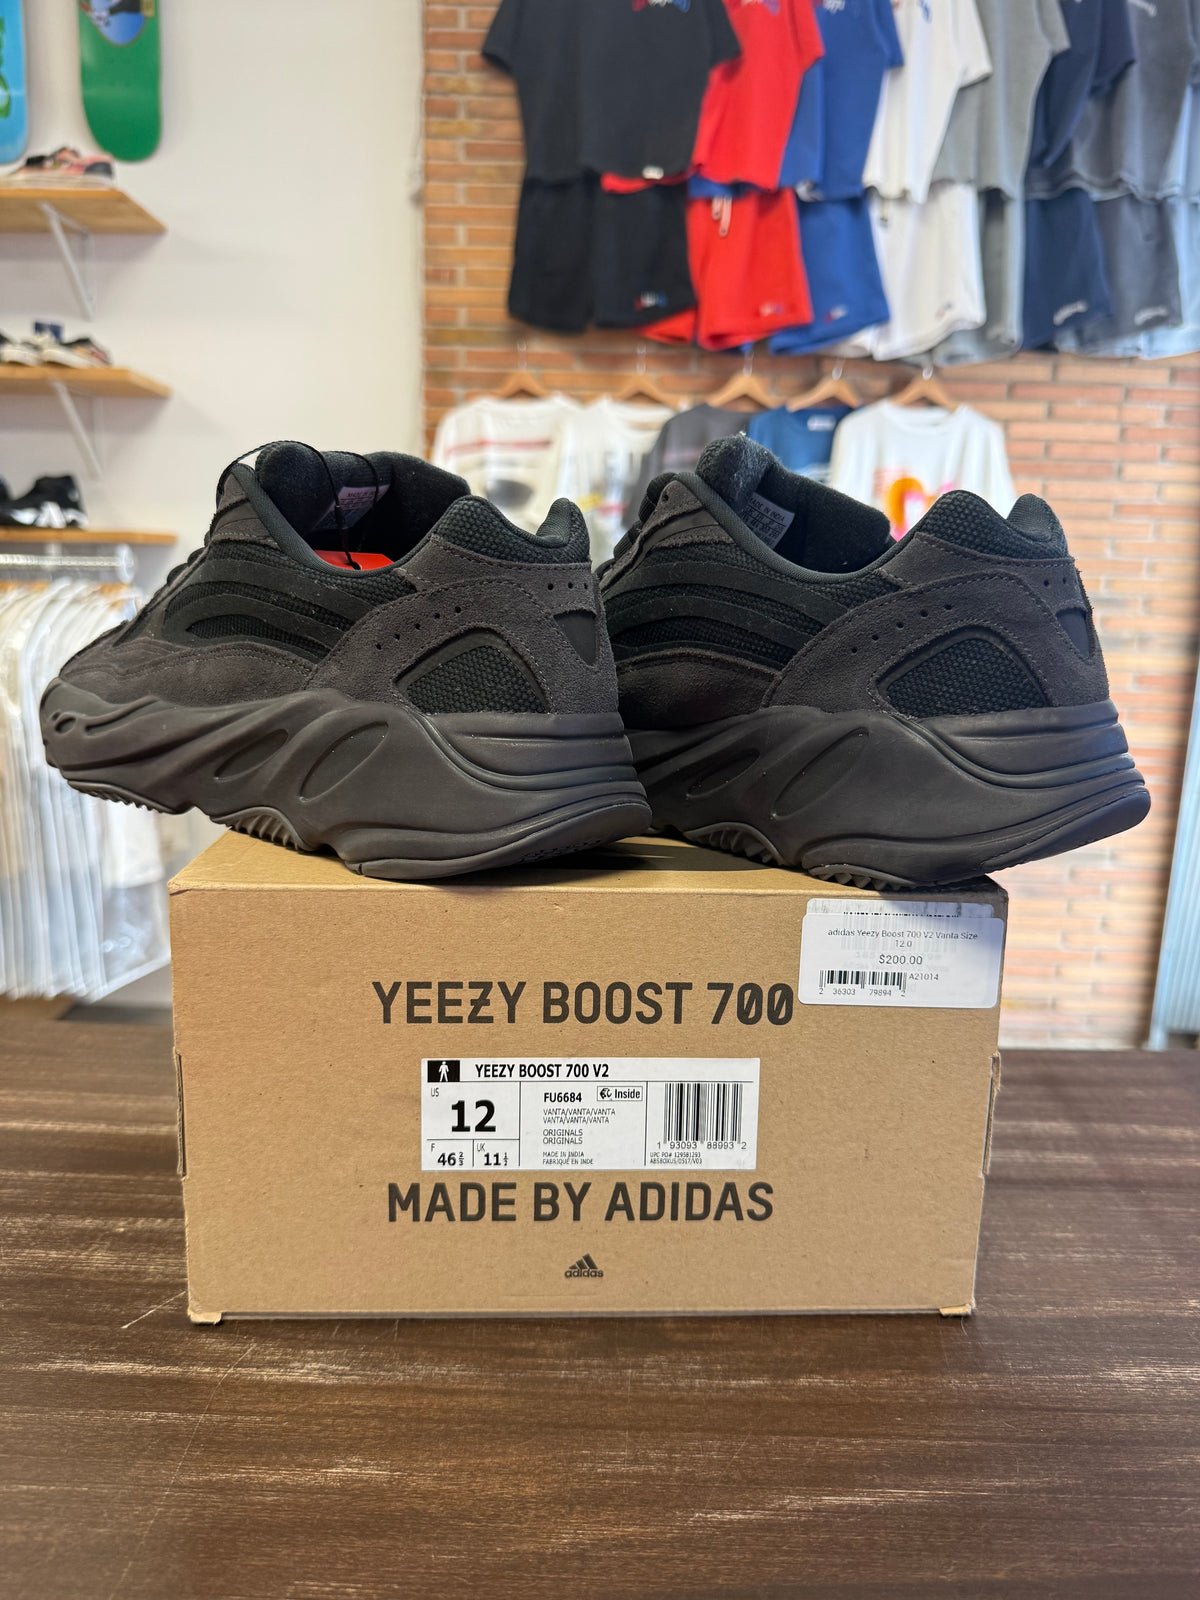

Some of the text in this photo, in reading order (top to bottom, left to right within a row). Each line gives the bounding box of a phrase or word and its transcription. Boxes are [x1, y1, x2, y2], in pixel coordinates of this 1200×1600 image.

[827, 928, 978, 940] adidas Yeezy Boost 700 V2 Vanta Size
[879, 954, 923, 965] $200.00
[908, 973, 939, 981] A21014
[818, 987, 824, 995] 2
[372, 981, 794, 1026] YEEZY BOOST 700
[475, 1064, 609, 1078] YEEZY BOOST 700 V2
[430, 1087, 439, 1097] US
[614, 1088, 641, 1099] Inside
[543, 1092, 582, 1103] FU6684
[451, 1099, 496, 1132] 12
[543, 1107, 616, 1116] VANTA/VANTA/VANTA
[543, 1116, 610, 1125] VANTA/VANTA/VANTA
[542, 1128, 583, 1137] ORIGINALS
[542, 1136, 583, 1145] ORIGINALS
[656, 1141, 747, 1150] 1 93093 88993 2
[430, 1142, 436, 1152] F
[476, 1142, 486, 1152] UK
[387, 1181, 774, 1223] MADE BY ADIDAS
[564, 1268, 604, 1279] adidas
